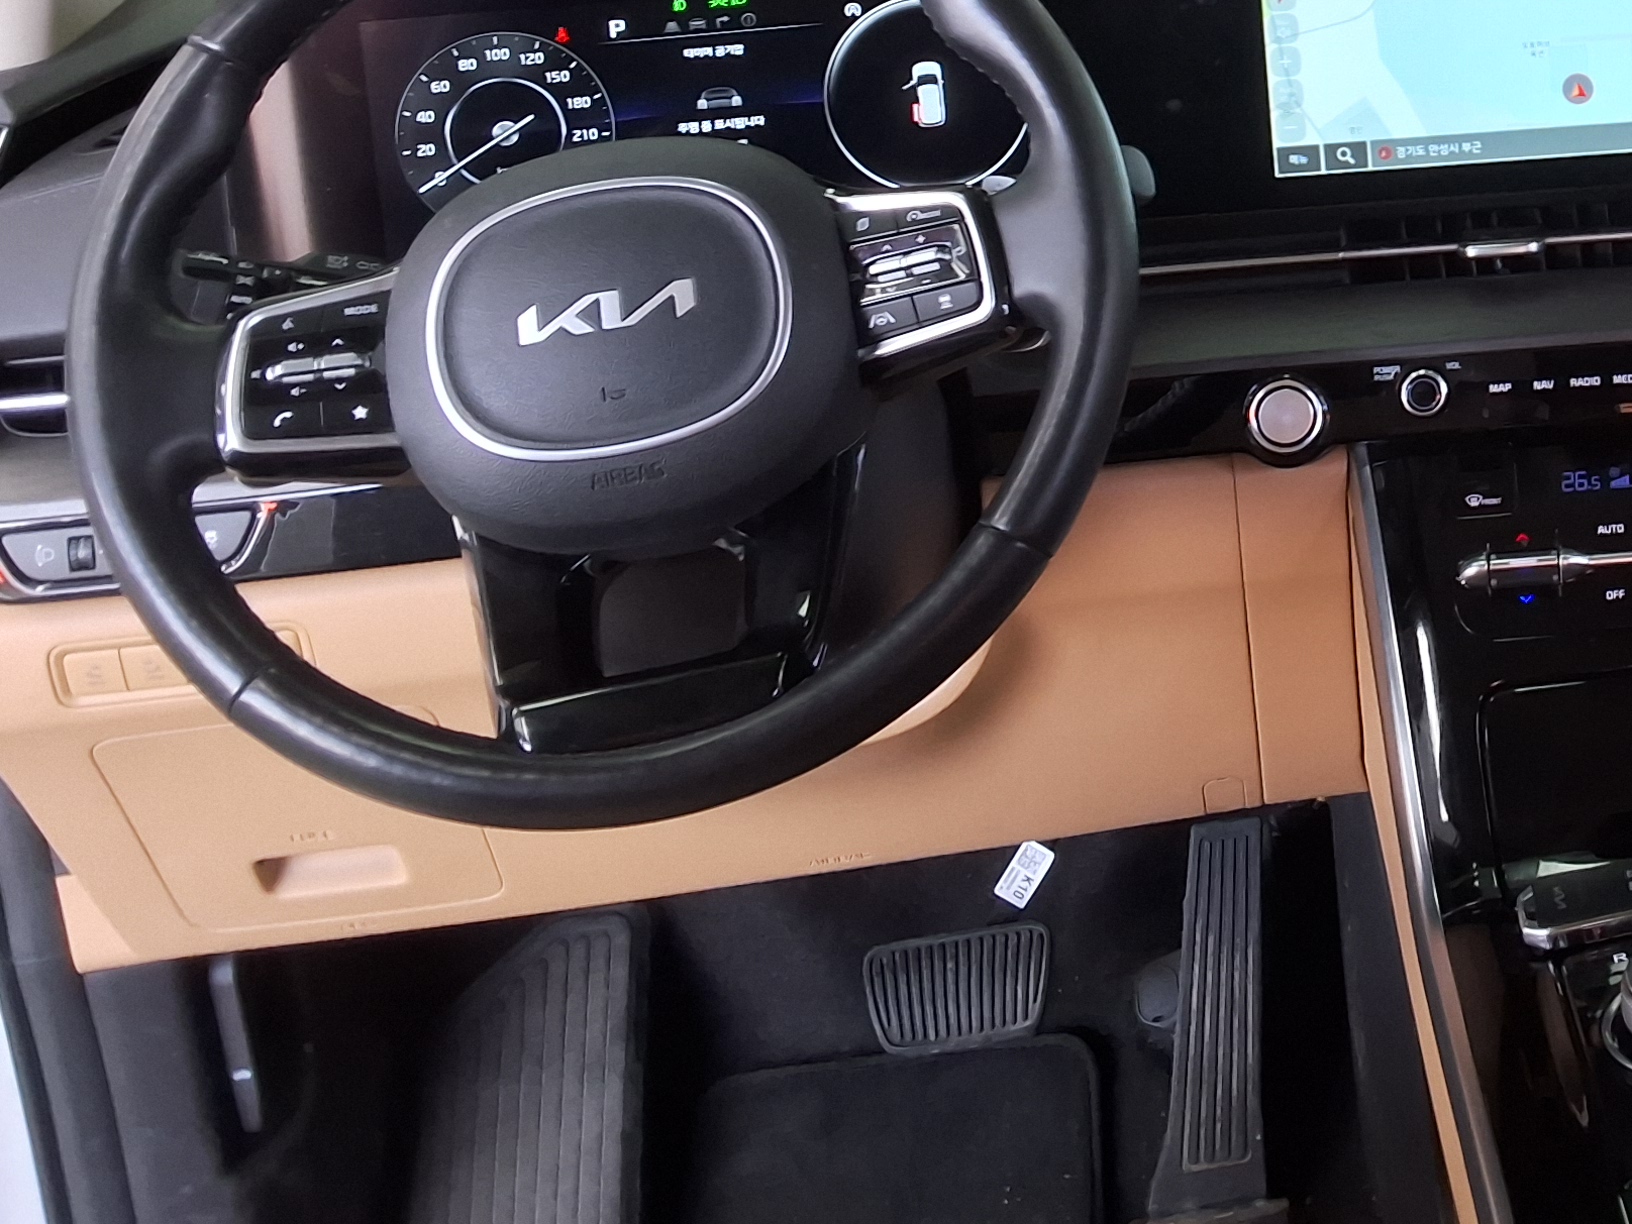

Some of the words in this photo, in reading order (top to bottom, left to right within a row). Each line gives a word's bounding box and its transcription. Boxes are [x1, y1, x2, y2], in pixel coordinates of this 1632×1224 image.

[608, 19, 626, 39] P
[484, 47, 511, 62] 100
[519, 51, 545, 66] 120
[457, 57, 478, 72] 80
[544, 70, 571, 84] 150
[430, 80, 450, 94] 60
[566, 95, 592, 110] 180
[415, 110, 436, 124] 40
[572, 128, 599, 143] 210
[416, 144, 436, 158] 20
[1396, 145, 1426, 158] 경기도
[1428, 142, 1459, 156] 안성시
[1462, 140, 1483, 154] 부근
[517, 277, 697, 346] KIA
[1489, 382, 1512, 393] MAP
[1533, 379, 1554, 390] NAV
[1570, 376, 1601, 387] RADIO
[1560, 471, 1601, 493] 26.5
[1597, 523, 1625, 535] AUTO
[1605, 589, 1626, 600] OFF
[1012, 873, 1035, 900] K10
[1613, 952, 1627, 963] R
